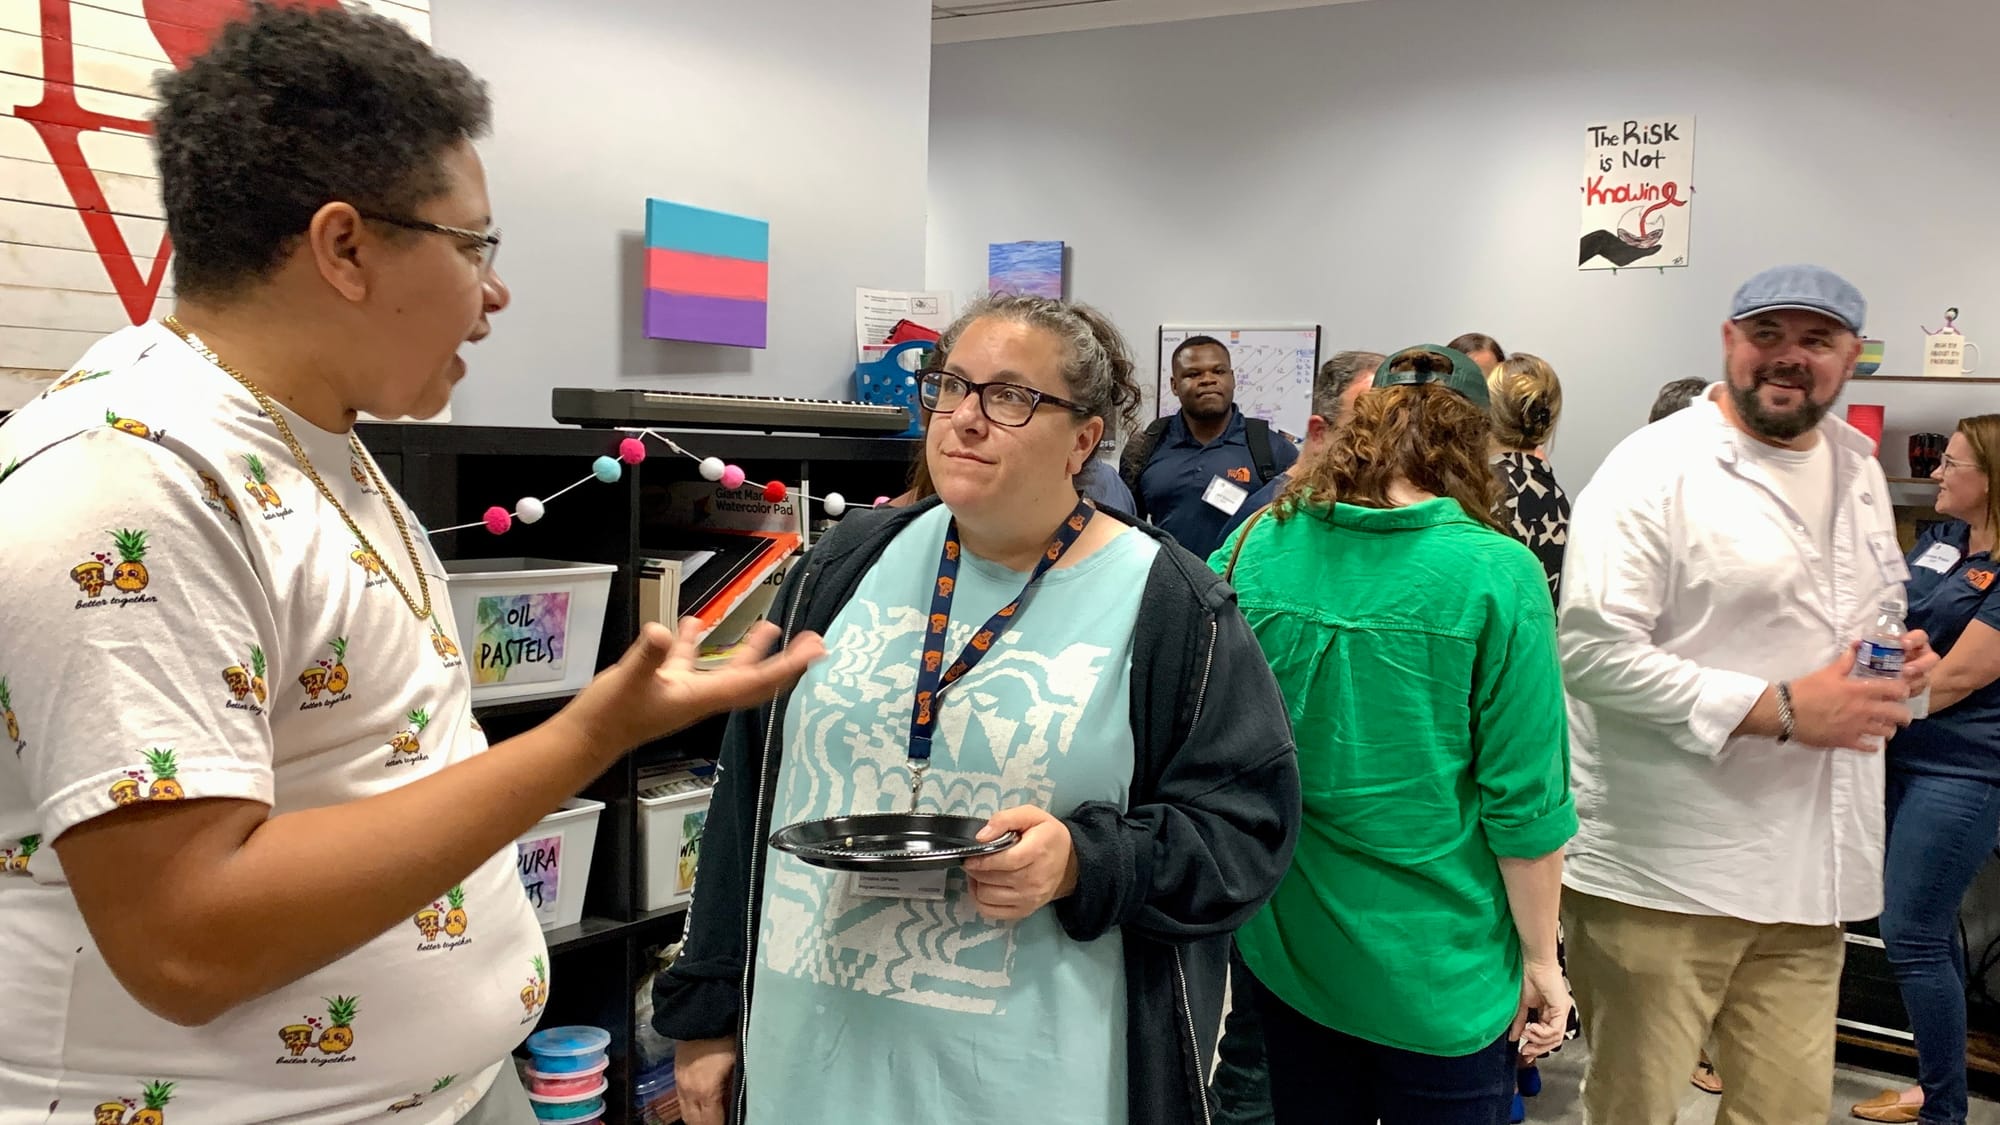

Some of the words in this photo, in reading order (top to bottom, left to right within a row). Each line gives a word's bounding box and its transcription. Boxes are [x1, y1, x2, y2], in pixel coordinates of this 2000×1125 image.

[1588, 126, 1619, 148] The
[1600, 155, 1613, 172] is
[1622, 149, 1666, 169] Not
[715, 488, 742, 500] Giant
[716, 501, 772, 514] Watercolor
[774, 503, 793, 516] Pad
[763, 567, 786, 586] ad
[75, 600, 107, 609] better
[110, 594, 157, 608] together
[507, 603, 535, 628] OIL
[480, 635, 555, 670] PASTELS
[416, 943, 441, 951] better
[443, 936, 472, 952] together
[276, 1056, 307, 1064] better
[311, 1054, 356, 1067] together
